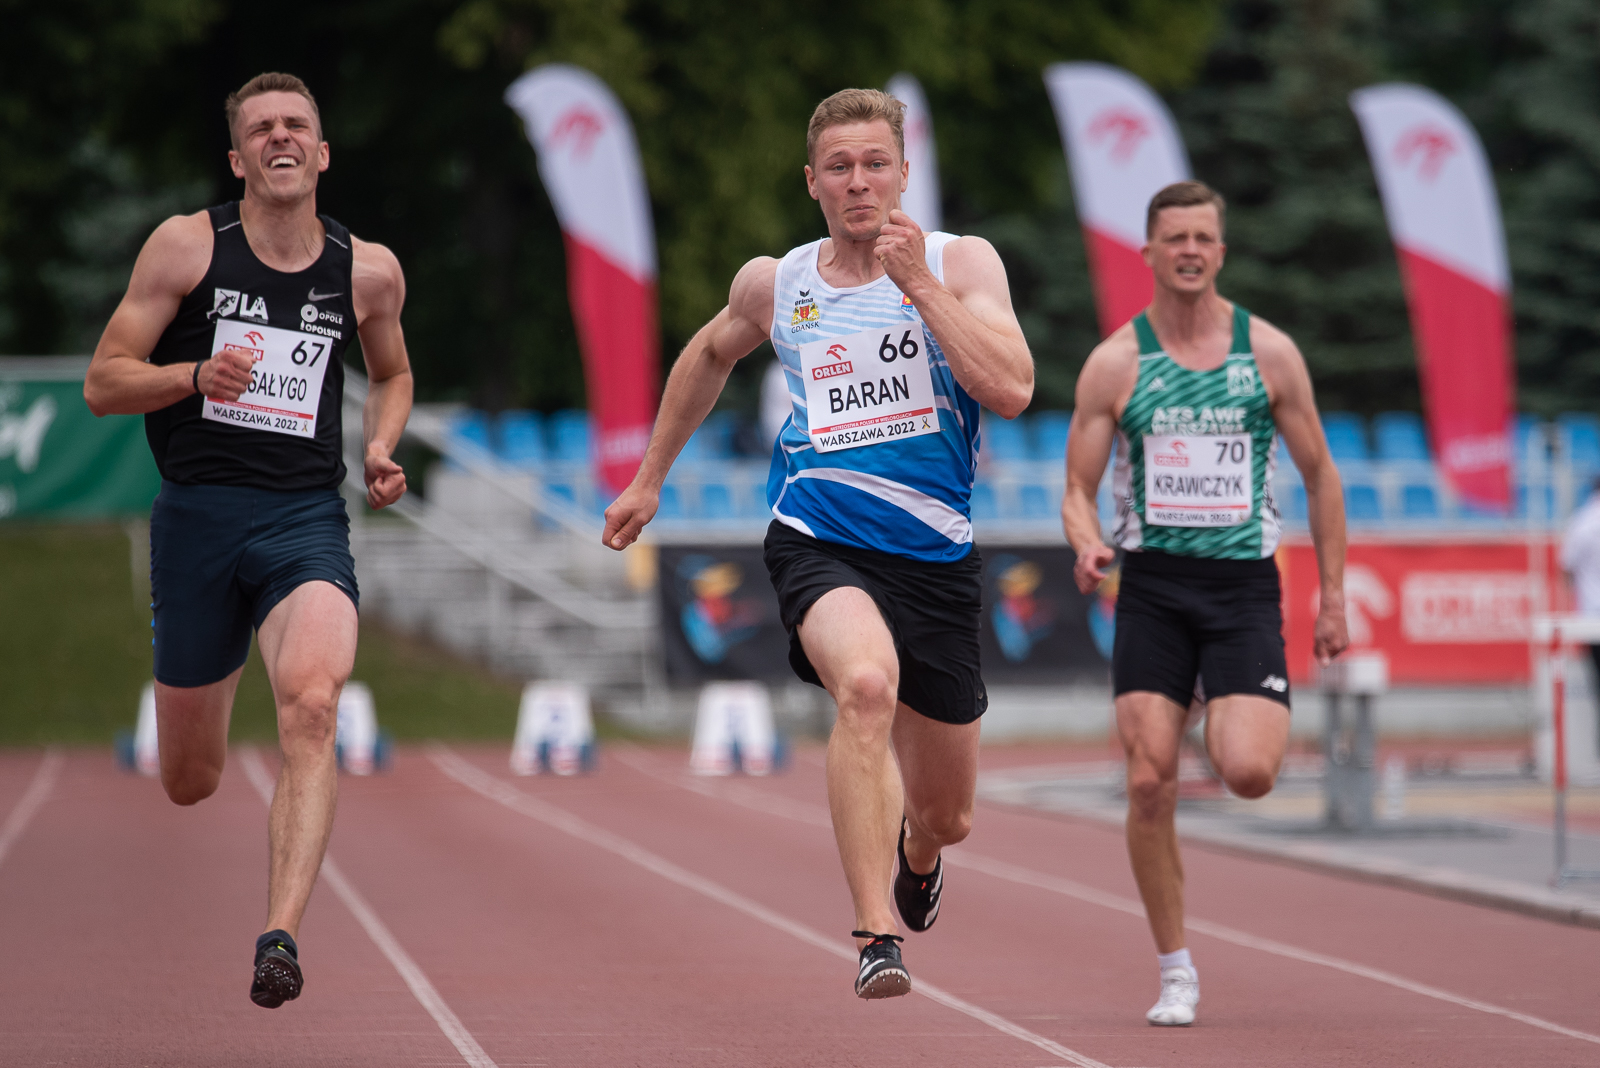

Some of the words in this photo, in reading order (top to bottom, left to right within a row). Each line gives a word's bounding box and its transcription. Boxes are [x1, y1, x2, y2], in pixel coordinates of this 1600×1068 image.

[795, 298, 813, 306] erima
[319, 312, 343, 325] OPOLE
[791, 321, 820, 334] GDAŃSK
[305, 323, 342, 340] OPOLSKIE
[291, 340, 325, 368] 67
[879, 330, 919, 363] 66
[814, 362, 851, 379] ORLEN
[247, 370, 307, 402] SAŁYGO
[828, 374, 910, 414] BARAN
[212, 405, 272, 426] WARSZAWA
[274, 417, 298, 431] 2022
[820, 427, 885, 447] WARSZAWA
[887, 421, 916, 436] 2022
[1215, 441, 1245, 465] 70
[1153, 473, 1244, 498] KRAWCZYK
